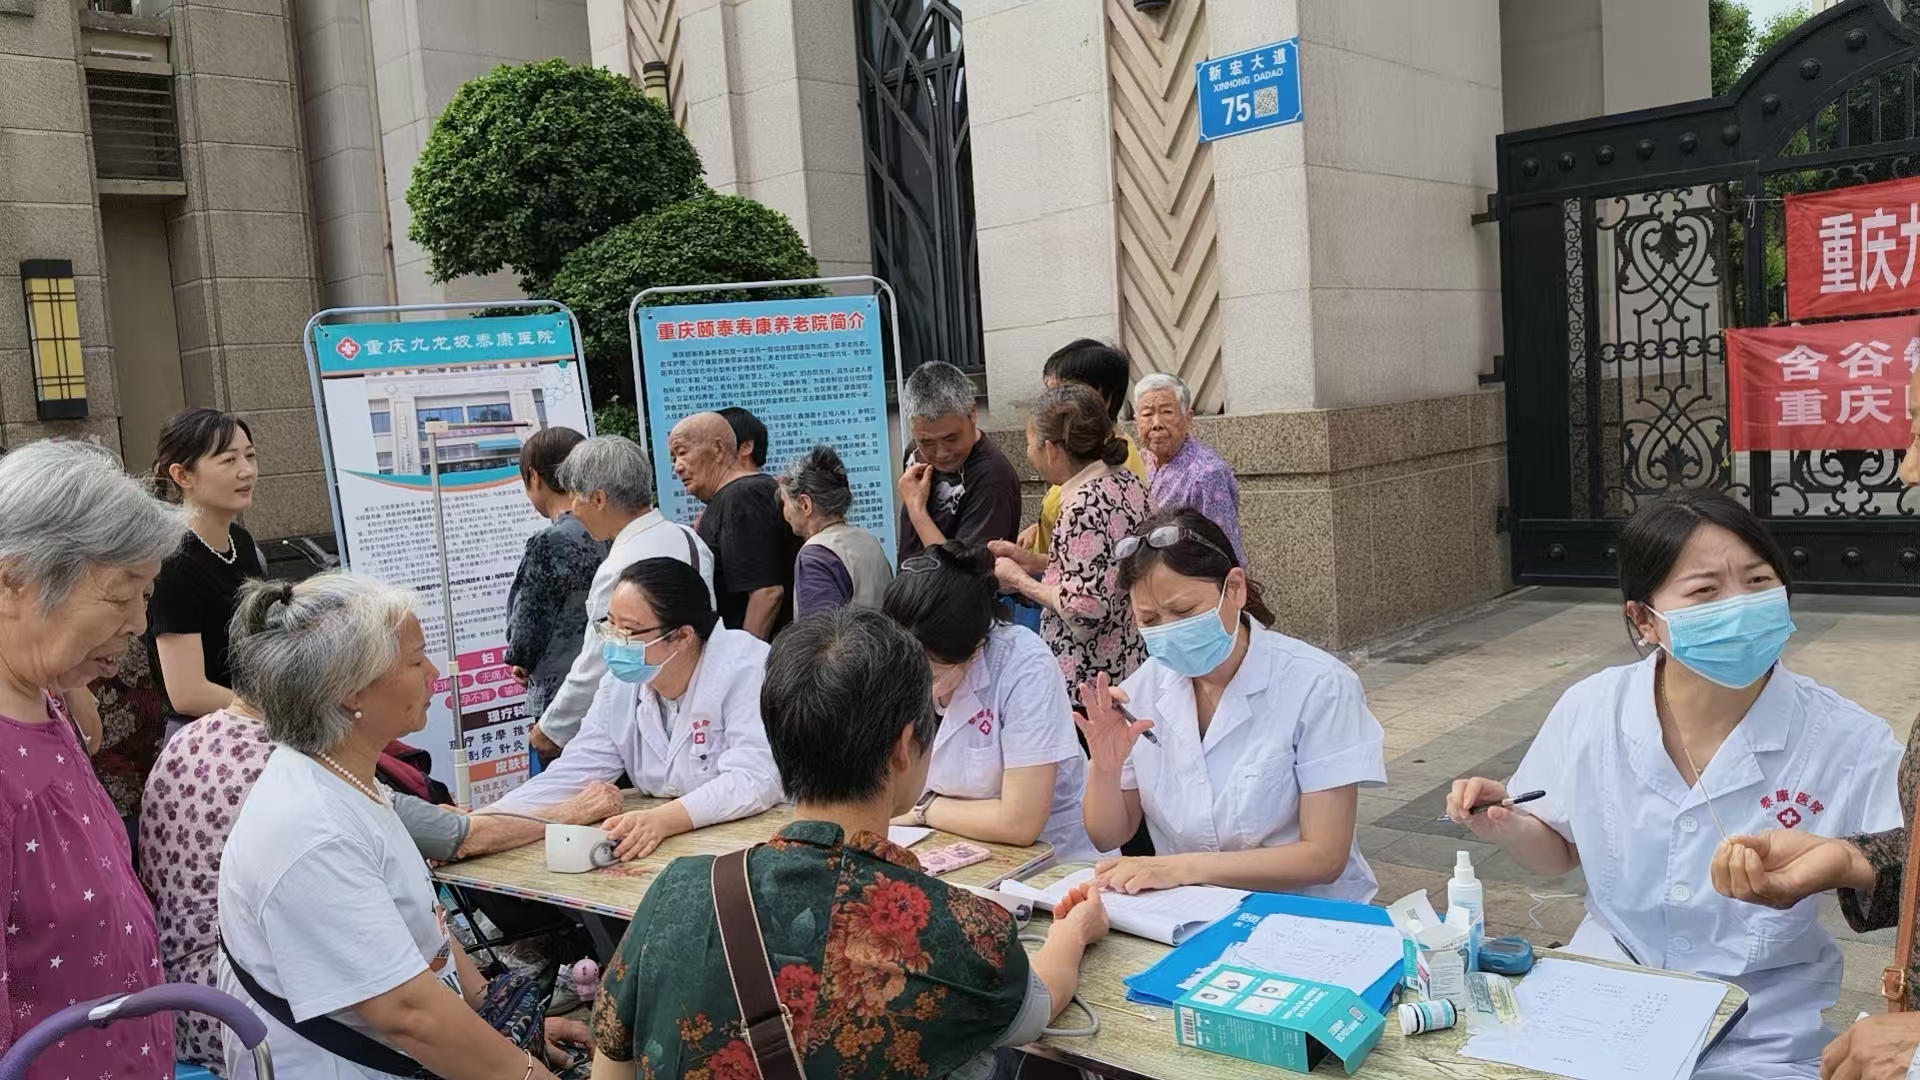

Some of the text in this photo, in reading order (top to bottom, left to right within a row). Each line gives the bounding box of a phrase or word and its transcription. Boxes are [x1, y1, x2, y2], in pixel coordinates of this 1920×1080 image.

[1208, 47, 1288, 82] 新宏大道
[1213, 68, 1284, 93] XINHONG DADAO
[1221, 93, 1252, 126] 75
[656, 311, 866, 341] 重庆颐泰寿康养老院简介
[363, 329, 557, 356] 重庆九龙坡泰康医院
[1775, 385, 1911, 426] 重庆
[459, 690, 491, 706] 孕不育
[504, 683, 527, 697] 输卵
[468, 740, 525, 761] 刮痧 针灸
[481, 731, 507, 744] 按摩
[1760, 789, 1824, 815] 泰康医院
